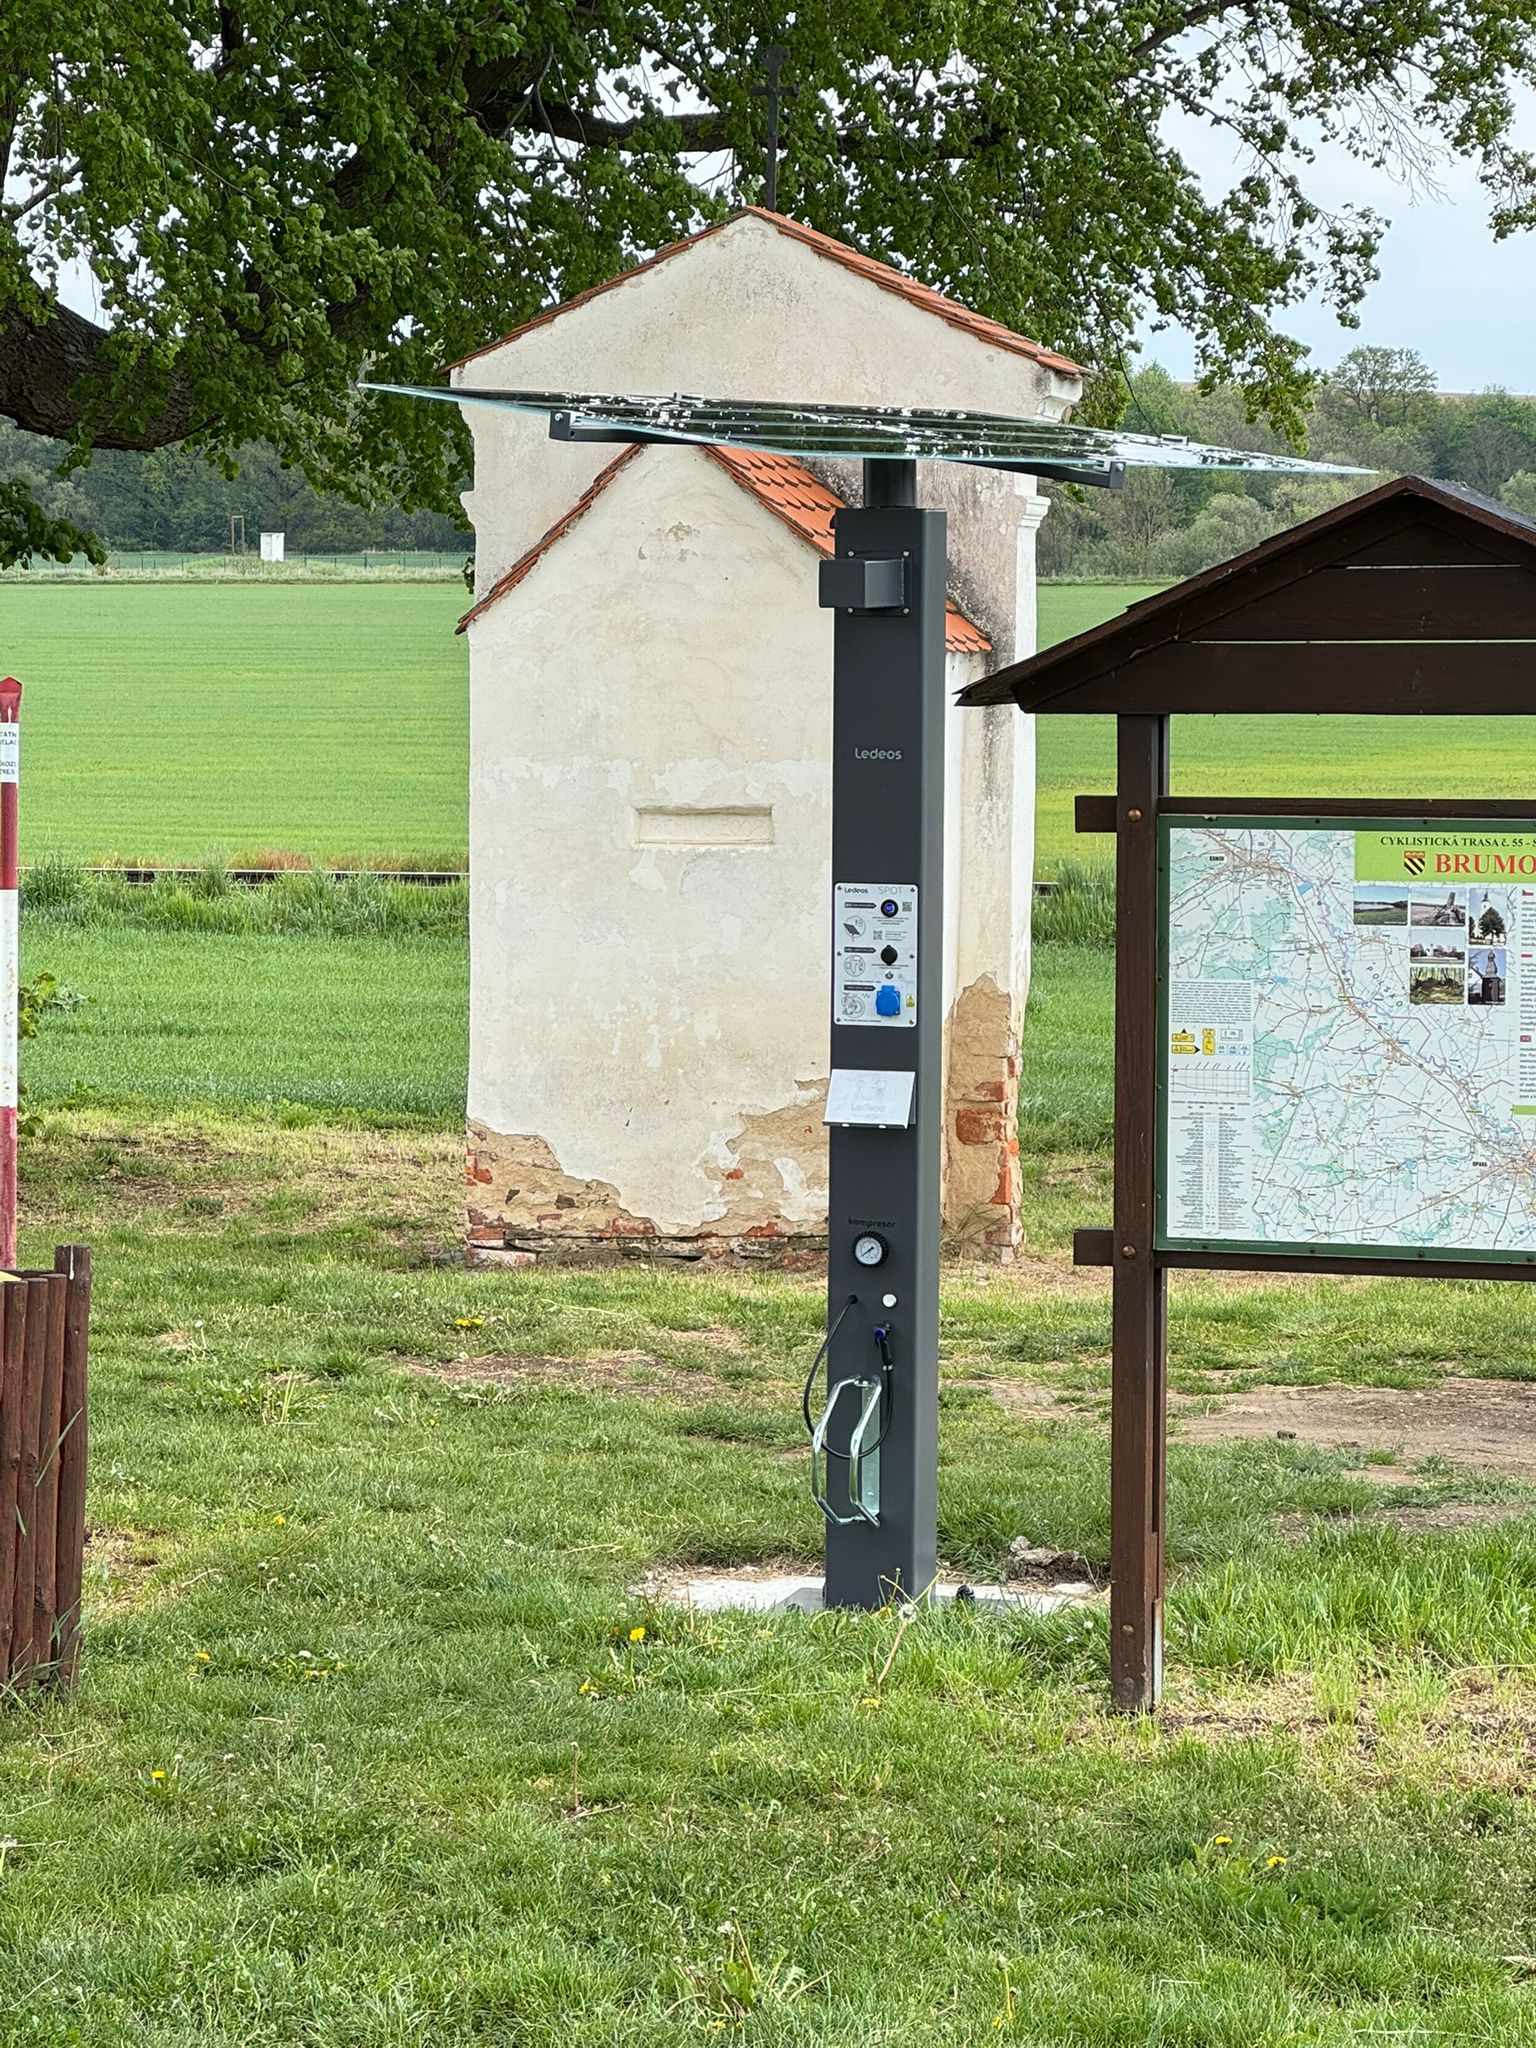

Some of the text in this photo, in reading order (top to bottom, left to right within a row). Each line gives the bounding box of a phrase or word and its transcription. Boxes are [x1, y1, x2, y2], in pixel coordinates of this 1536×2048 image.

[855, 747, 902, 760] Ledeos
[1380, 835, 1459, 847] CYKLISTICKÁ
[1461, 837, 1499, 847] TRASA
[1512, 838, 1524, 847] 55
[1434, 853, 1536, 875] BRUMO
[879, 886, 903, 895] SPOT
[848, 1217, 896, 1228] kompresor
